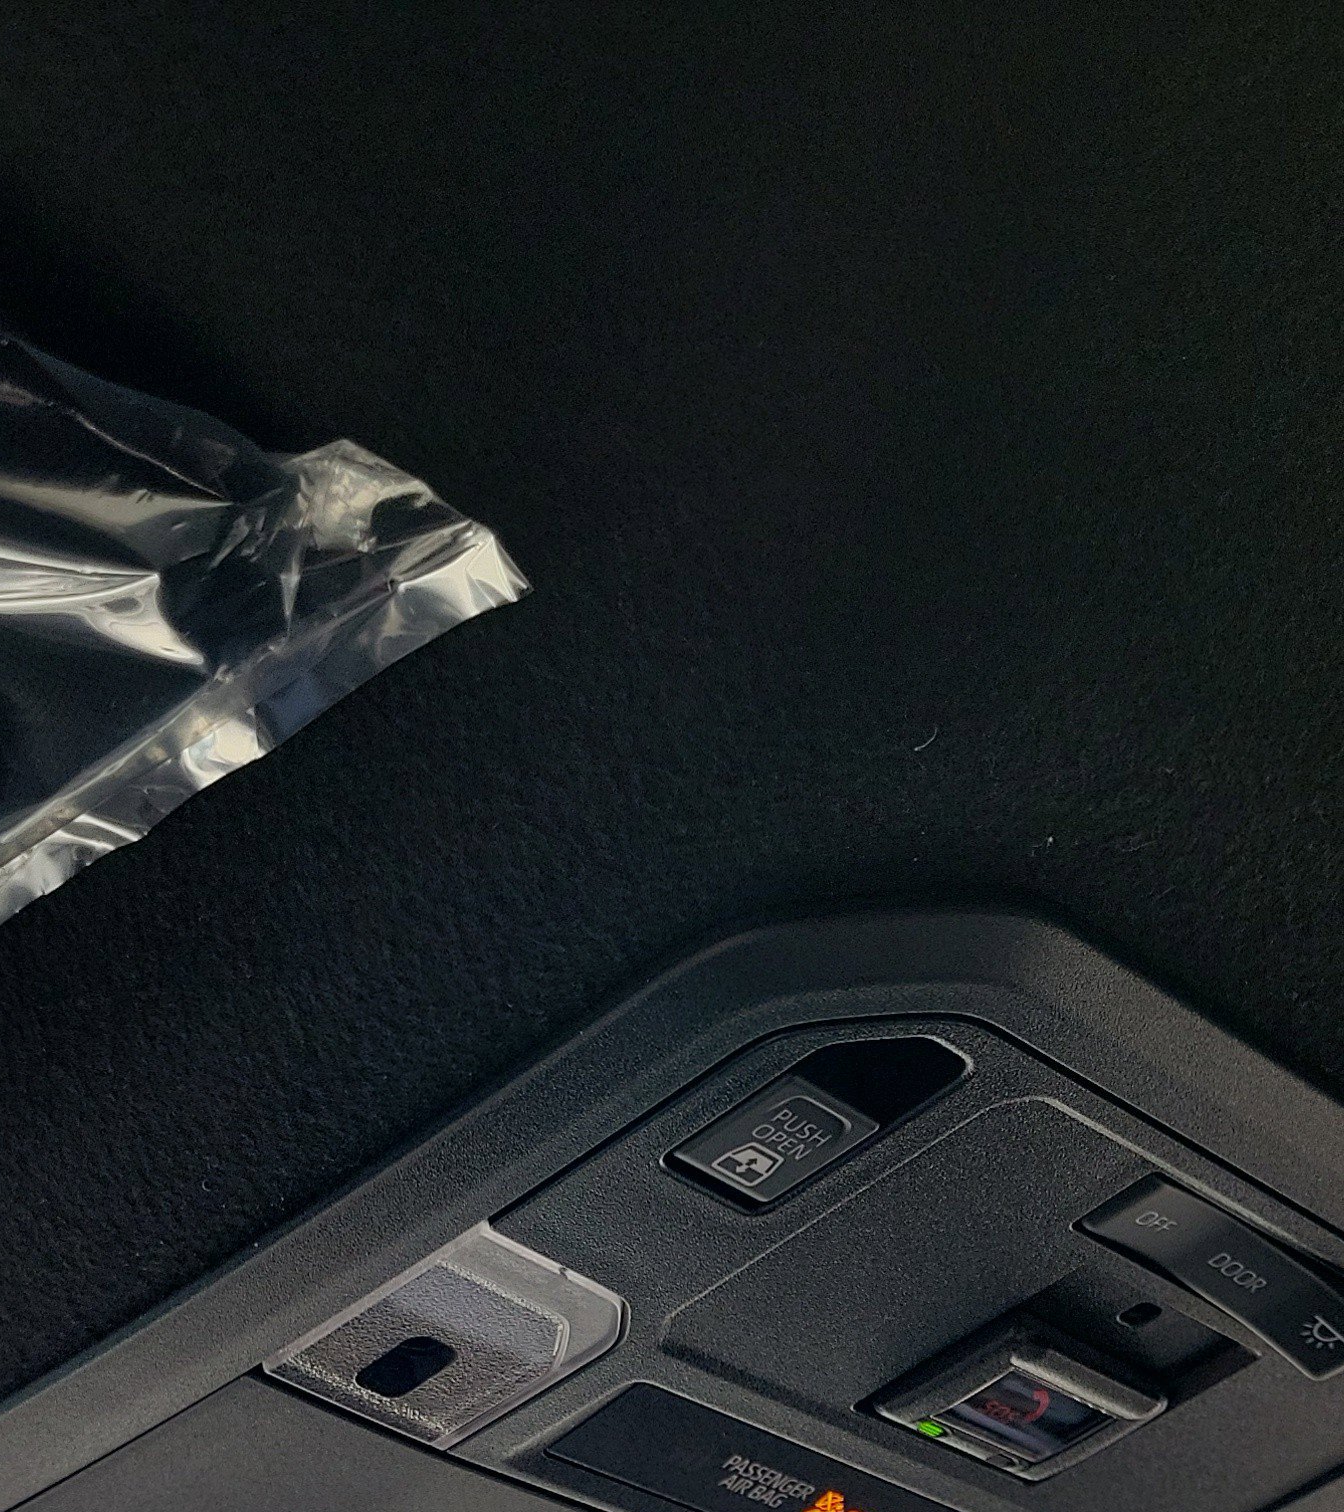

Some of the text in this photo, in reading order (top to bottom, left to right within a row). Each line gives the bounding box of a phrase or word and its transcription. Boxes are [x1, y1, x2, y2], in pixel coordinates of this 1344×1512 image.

[752, 1124, 813, 1160] OPEN
[771, 1109, 832, 1148] PUSH
[1135, 1211, 1177, 1232] OFF
[1208, 1252, 1267, 1294] DOOR
[718, 1474, 788, 1508] AIR BAG
[722, 1455, 815, 1501] PASSENGER
